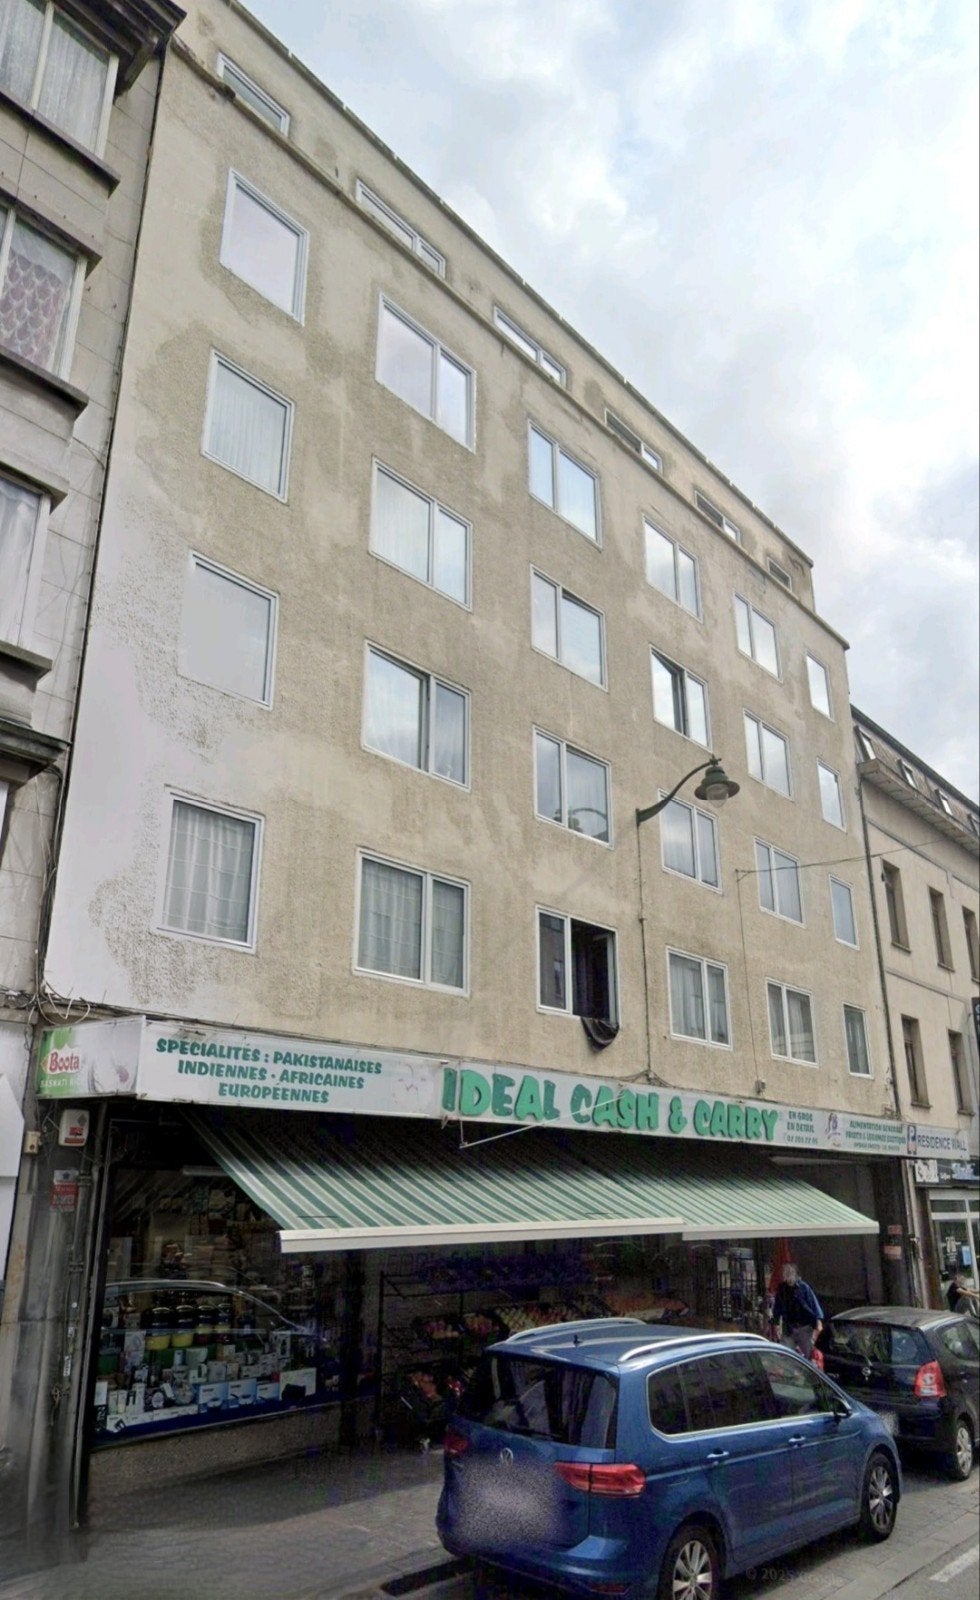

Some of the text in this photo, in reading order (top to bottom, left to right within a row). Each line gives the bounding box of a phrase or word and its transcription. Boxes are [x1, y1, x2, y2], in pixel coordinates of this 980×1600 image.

[49, 1052, 80, 1072] Boota
[178, 1060, 267, 1081] INDIENNES
[280, 1069, 365, 1089] AFRICAINES
[273, 1051, 382, 1075] PAKISTANAISES
[442, 1067, 779, 1141] IDEAL CASH & CARRY
